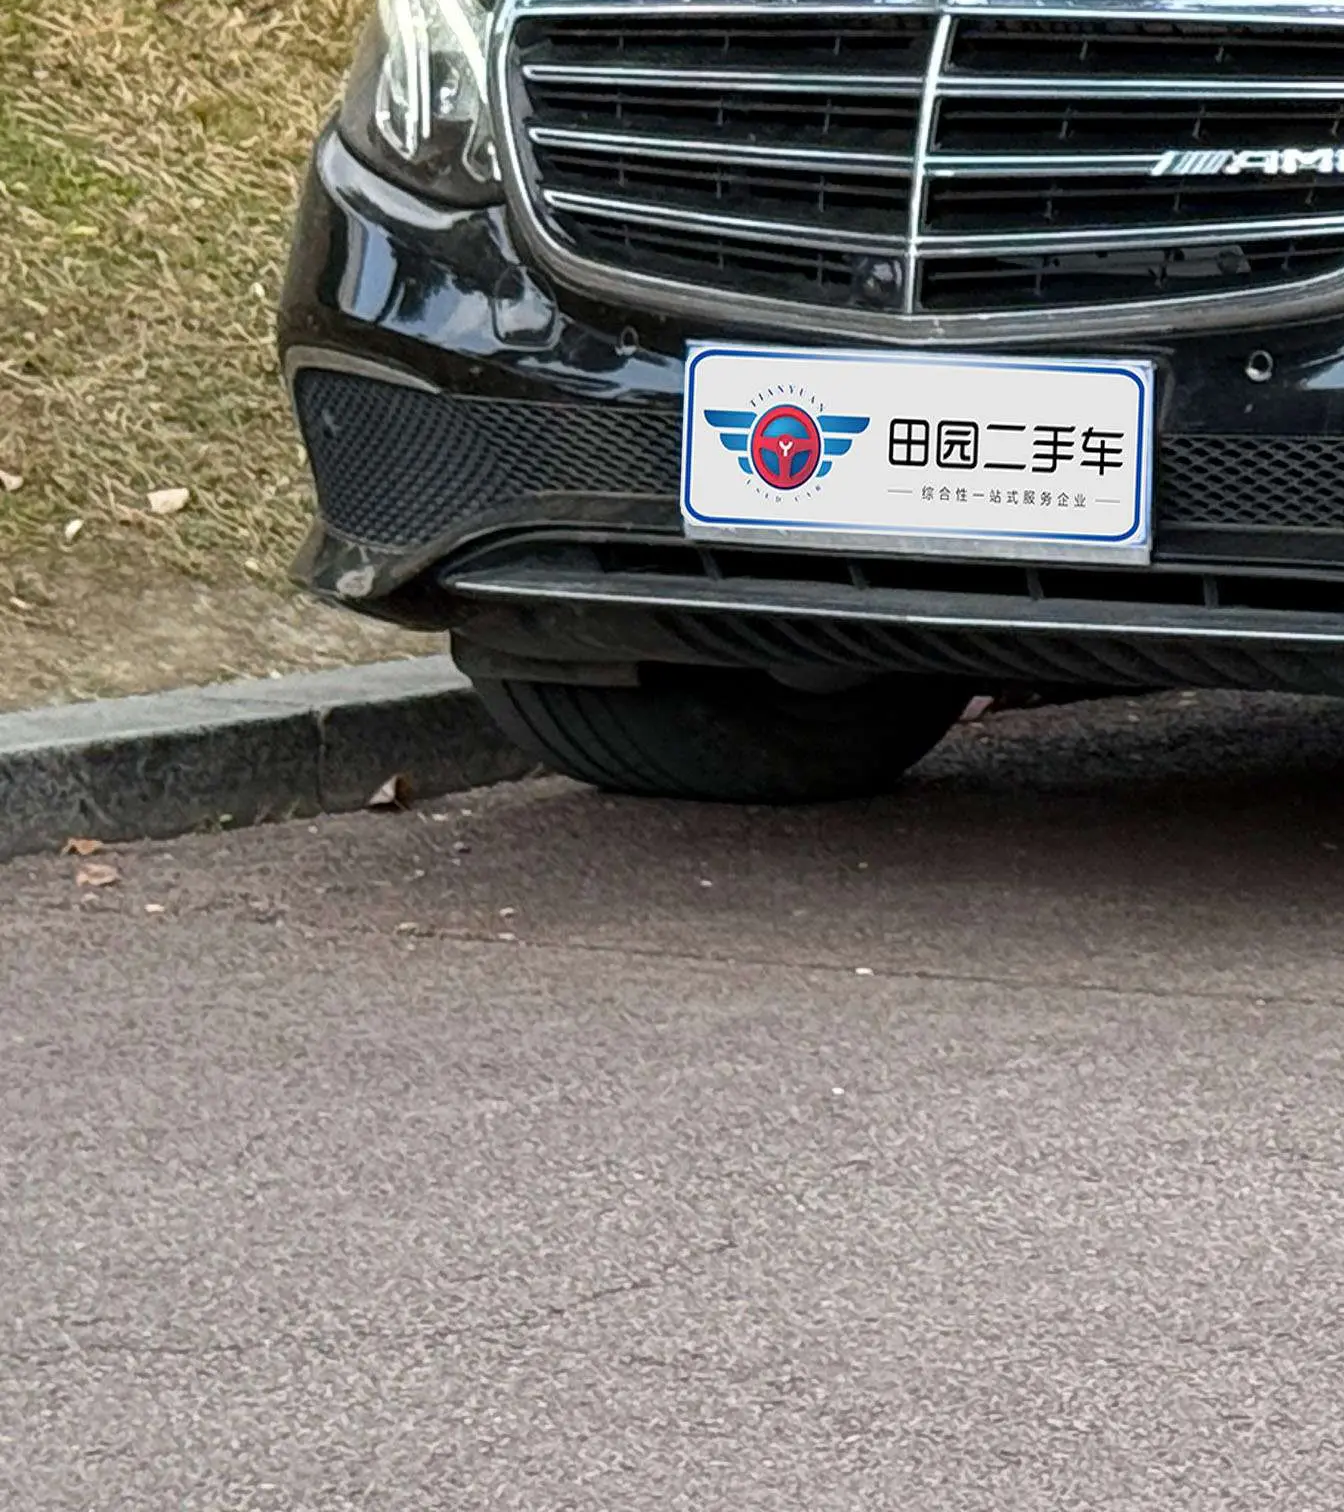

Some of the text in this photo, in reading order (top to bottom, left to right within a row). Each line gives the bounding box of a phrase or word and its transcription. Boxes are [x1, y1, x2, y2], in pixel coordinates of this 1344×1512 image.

[888, 417, 1125, 476] 田园二手车
[921, 484, 1087, 509] 综合性一站式服务企业
